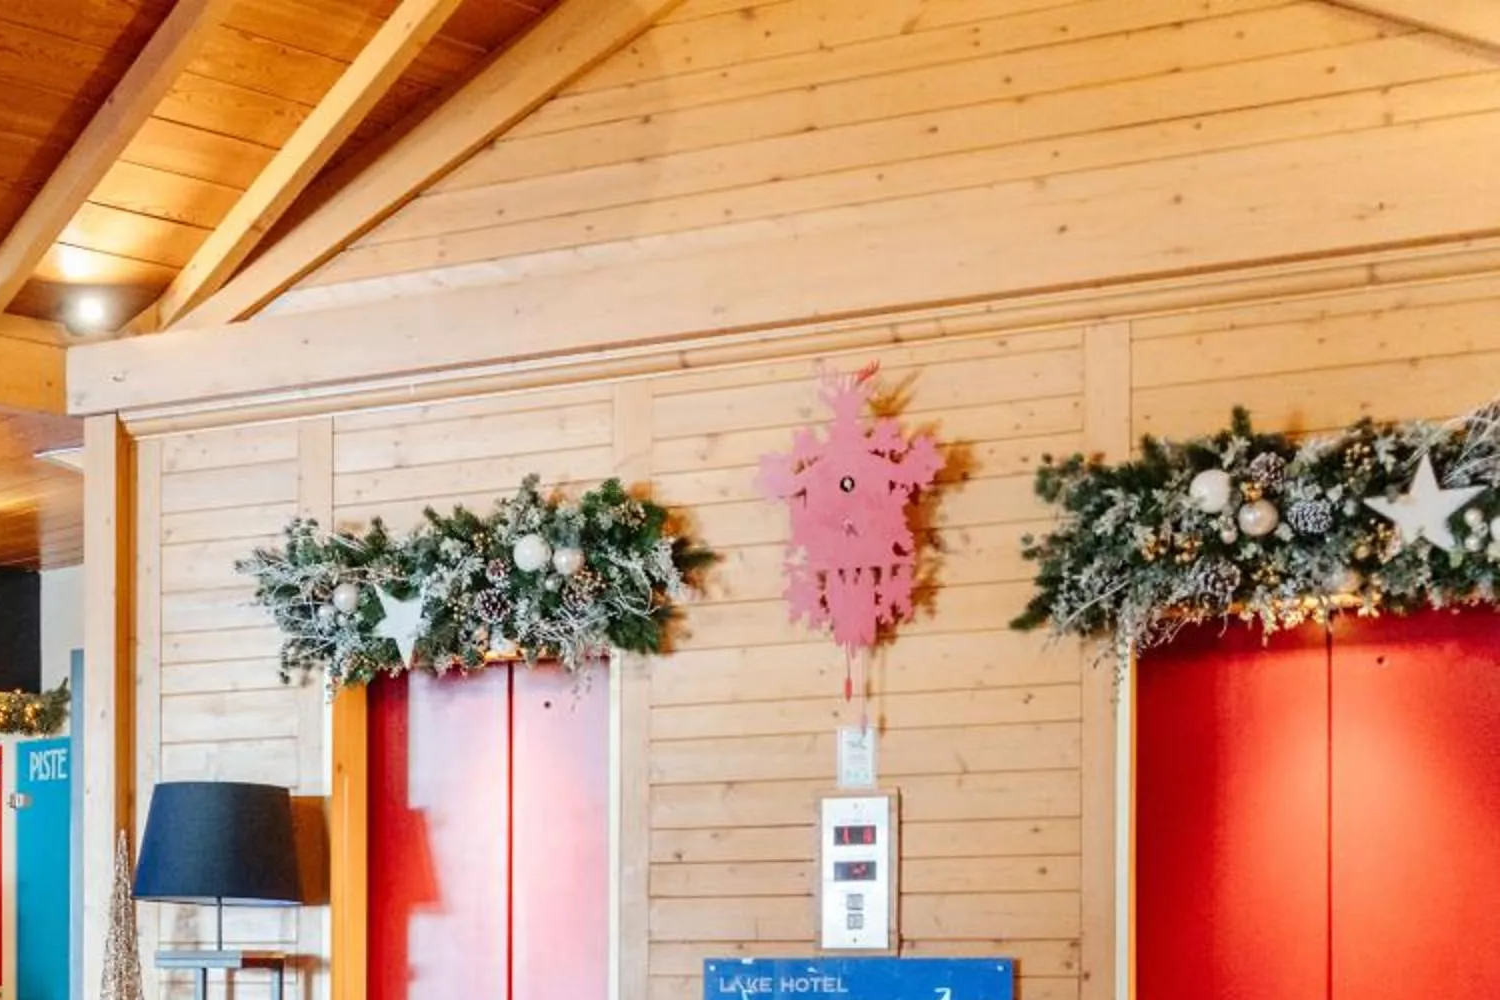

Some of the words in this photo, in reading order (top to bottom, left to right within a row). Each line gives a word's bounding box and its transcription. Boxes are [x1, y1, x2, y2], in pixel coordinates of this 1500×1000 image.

[28, 748, 69, 782] PISTE
[719, 976, 773, 993] LAKE
[780, 976, 849, 993] HOTEL
